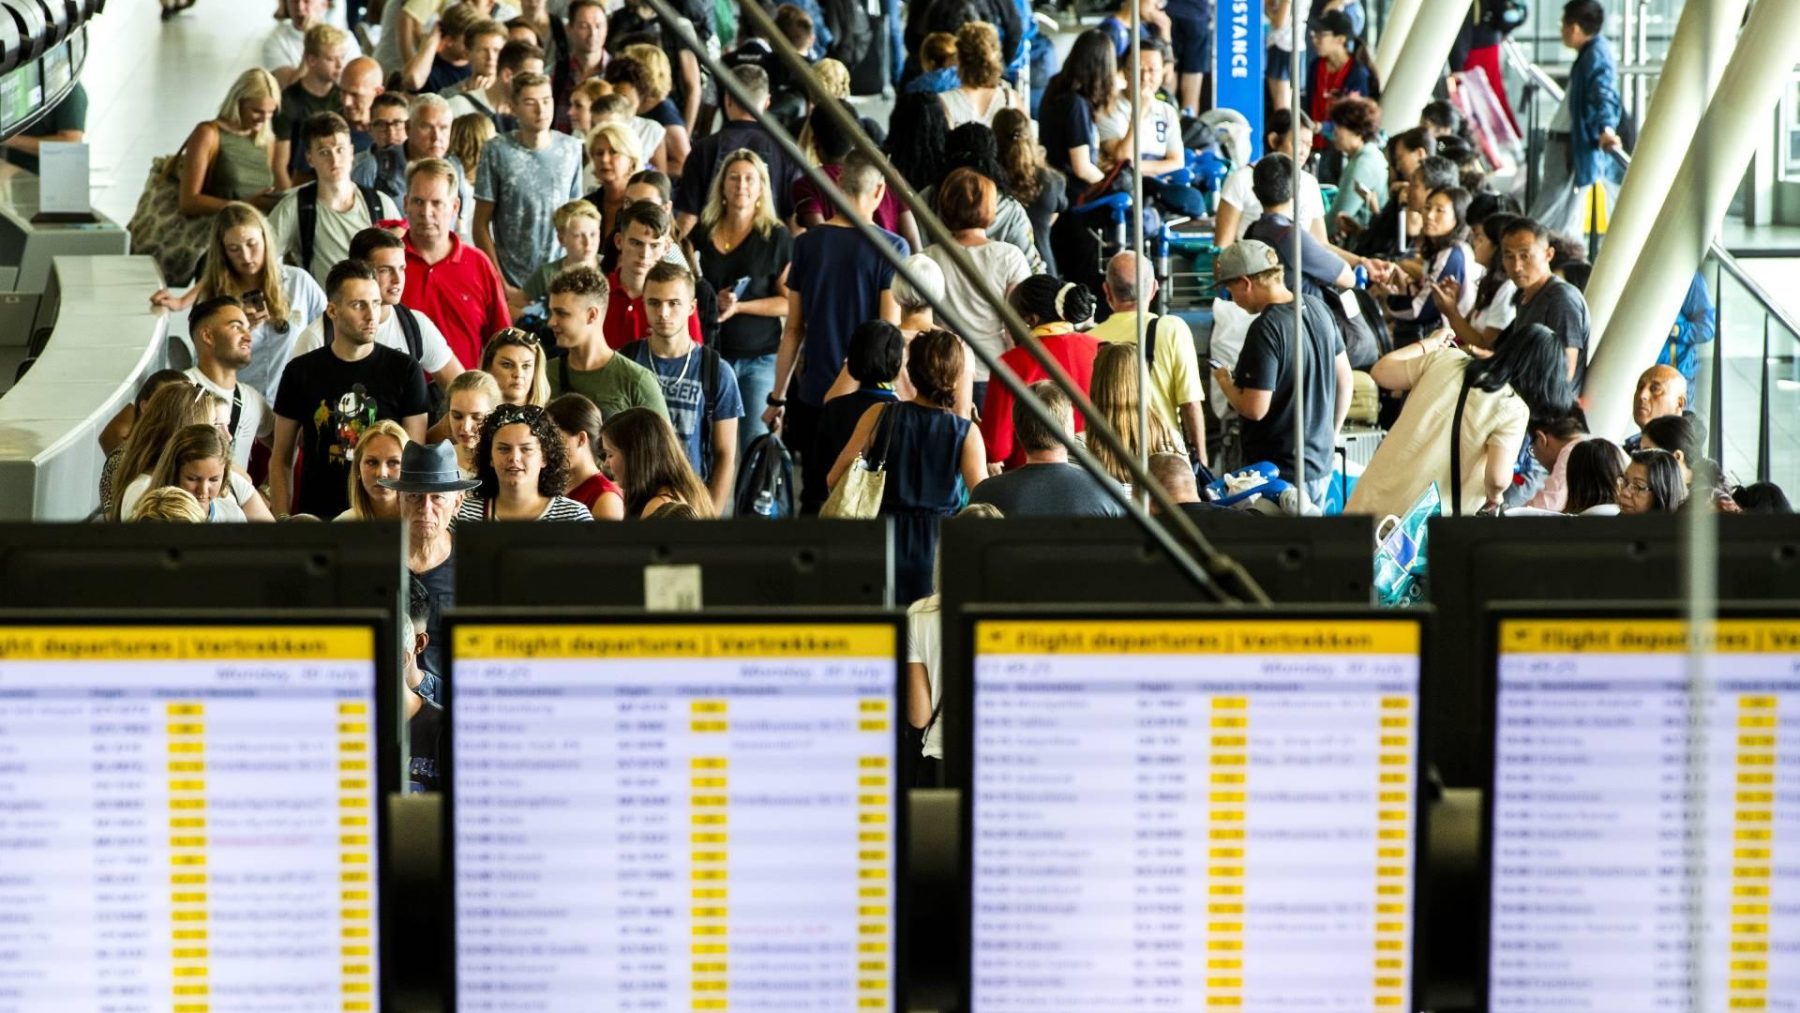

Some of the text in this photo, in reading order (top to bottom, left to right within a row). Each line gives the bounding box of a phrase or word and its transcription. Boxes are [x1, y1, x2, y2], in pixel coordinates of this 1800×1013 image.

[1232, 0, 1248, 79] STANCE
[42, 637, 173, 659] departures
[192, 637, 328, 655] Vertrekken
[493, 635, 562, 657] Flight
[567, 635, 698, 657] departures
[717, 635, 851, 654] Vertrekken
[1015, 630, 1085, 653] Flight
[1090, 630, 1221, 653] departures
[1239, 630, 1373, 649] Vertrekken
